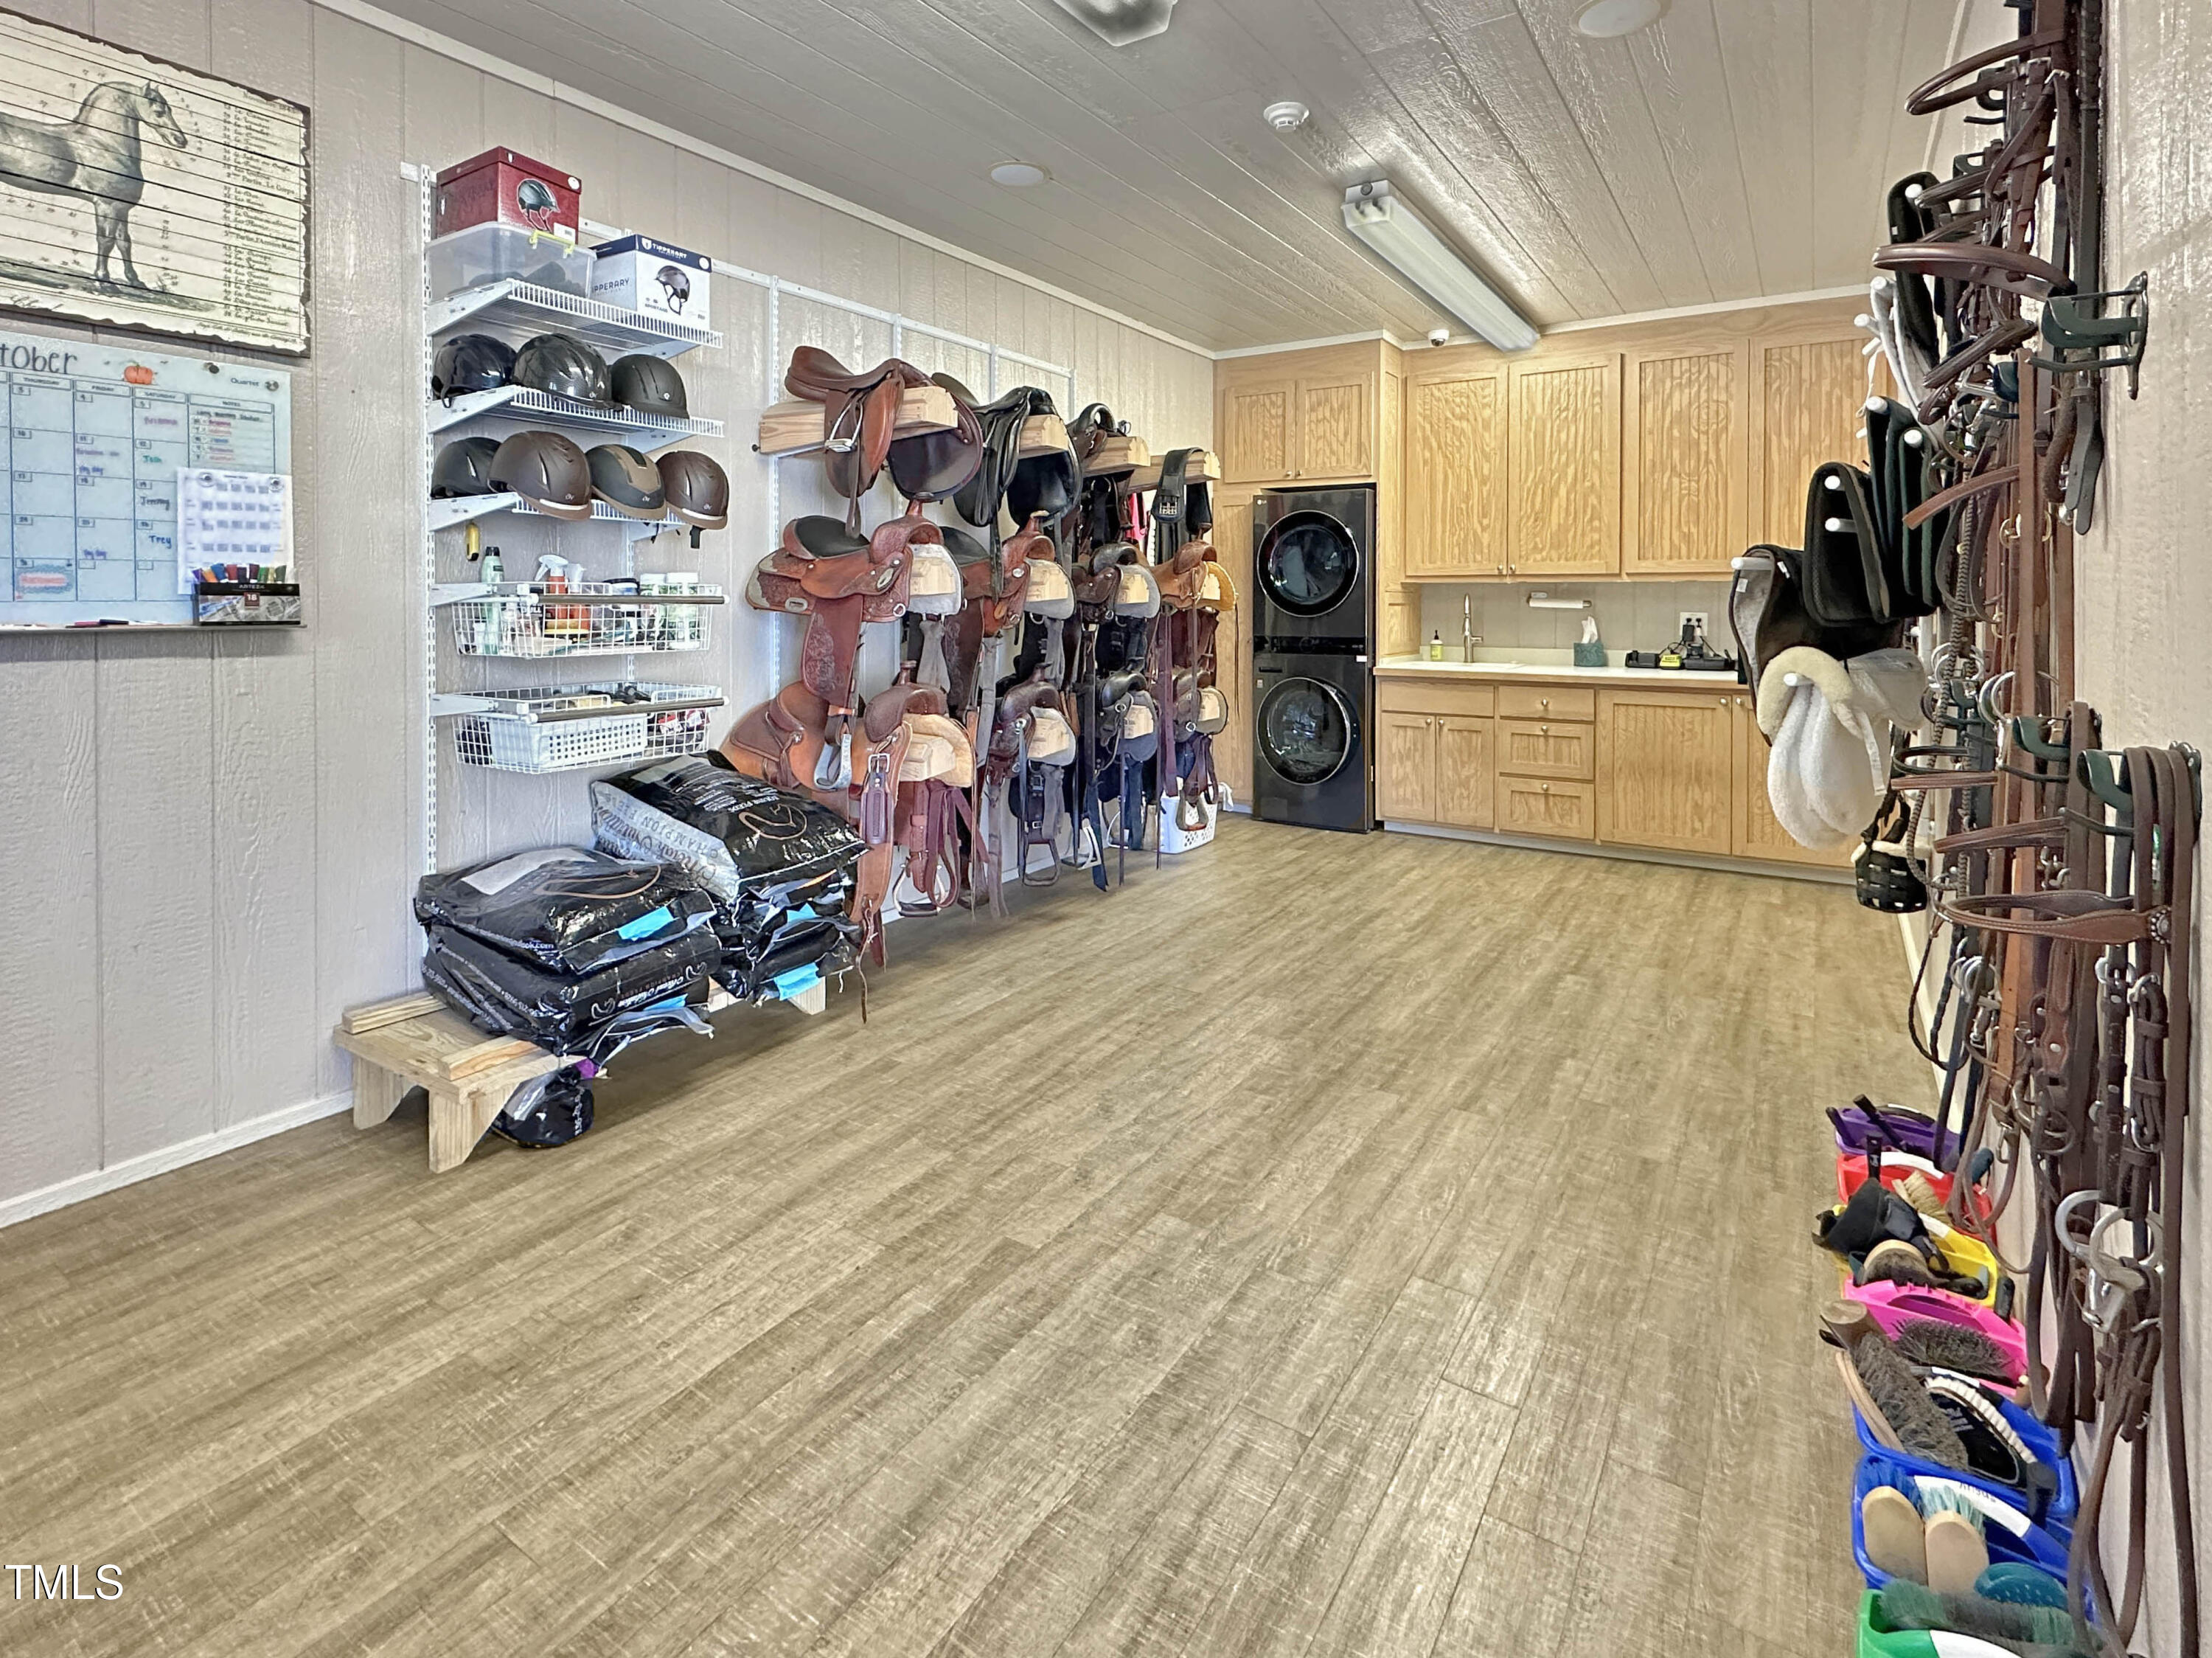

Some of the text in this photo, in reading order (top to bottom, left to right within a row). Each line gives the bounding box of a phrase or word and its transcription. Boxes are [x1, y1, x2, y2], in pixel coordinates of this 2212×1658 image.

[591, 277, 630, 294] IPPERARY
[148, 535, 173, 549] Trey
[641, 815, 719, 859] CHAMPION
